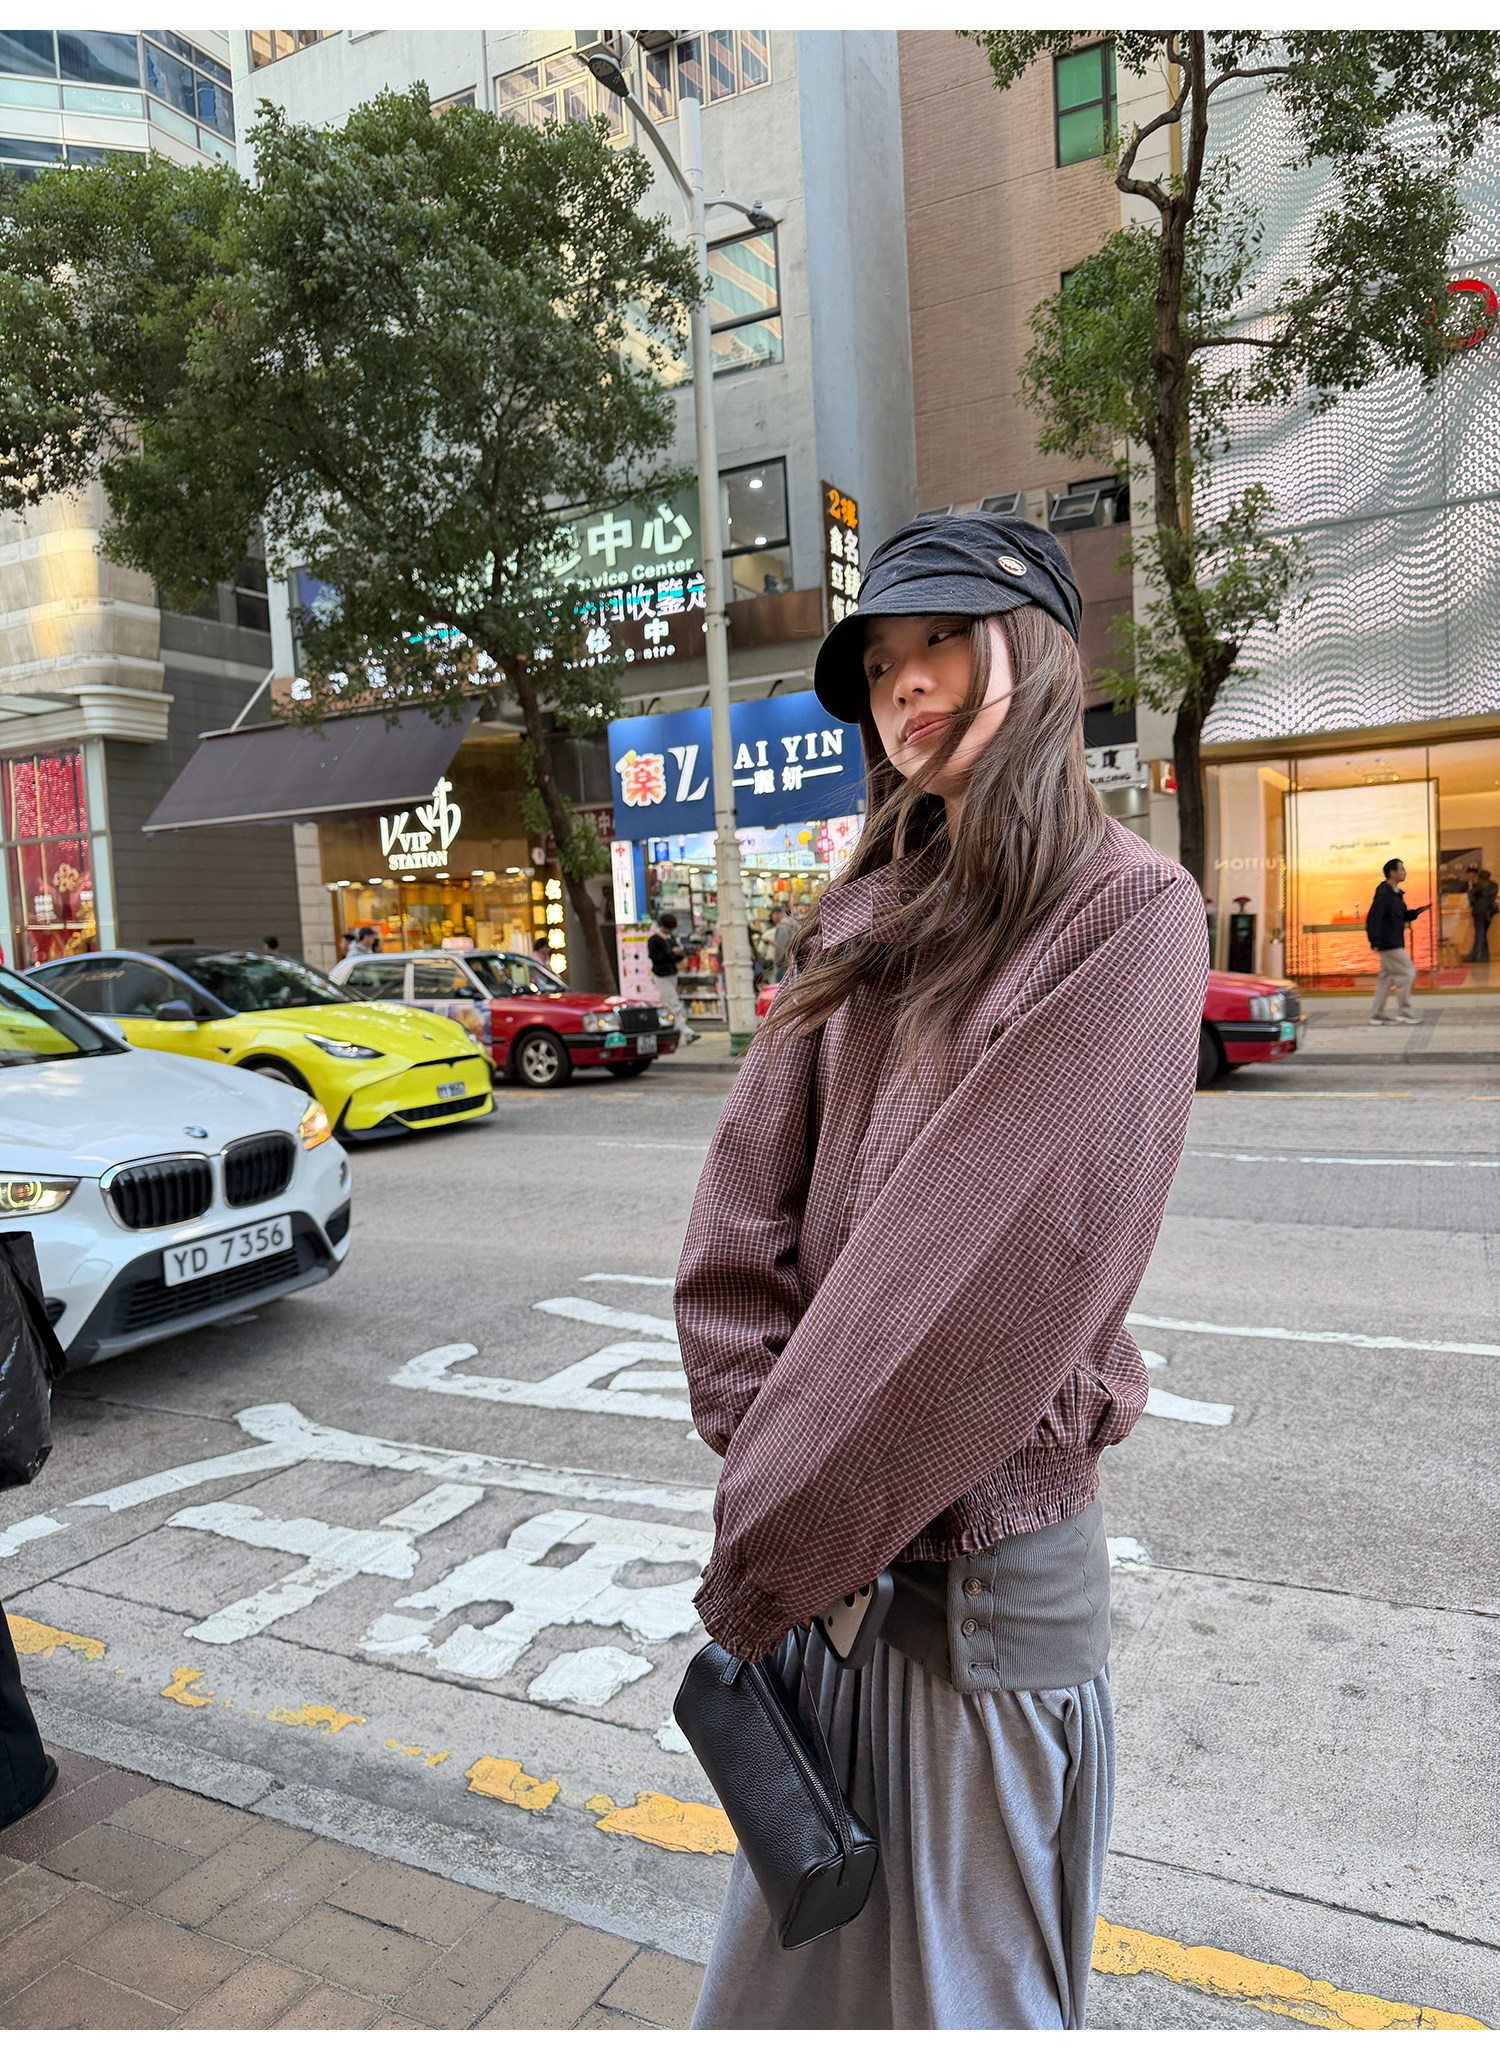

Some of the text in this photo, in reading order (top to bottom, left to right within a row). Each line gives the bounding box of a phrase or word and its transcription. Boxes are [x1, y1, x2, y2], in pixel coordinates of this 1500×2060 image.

[631, 556, 695, 581] Center
[624, 644, 676, 662] Cntre
[733, 728, 844, 770] AI YIN
[397, 831, 432, 853] VIP
[388, 850, 449, 871] STATION
[172, 1223, 284, 1277] YD 7356
